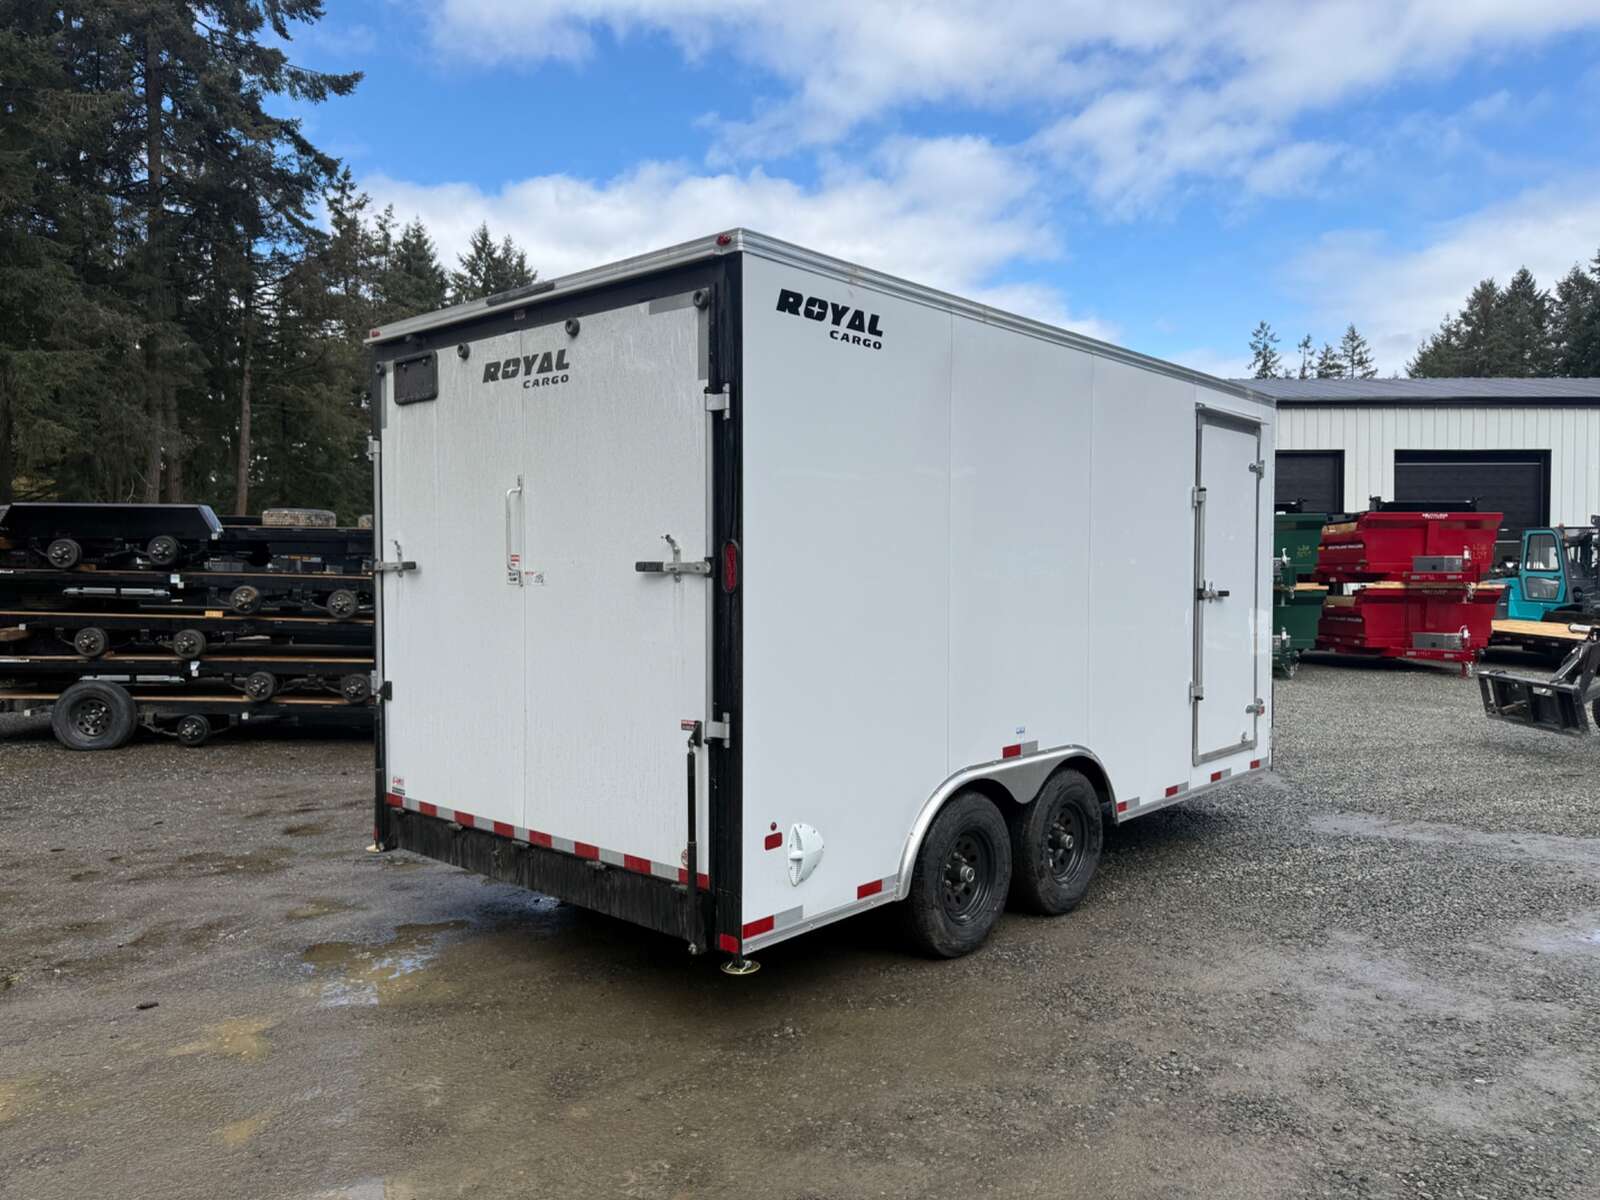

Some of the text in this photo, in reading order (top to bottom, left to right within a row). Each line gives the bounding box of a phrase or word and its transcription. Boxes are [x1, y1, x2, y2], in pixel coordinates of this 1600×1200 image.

[776, 288, 883, 338] ROYAL
[829, 330, 882, 350] CARGO
[482, 348, 570, 384] ROYAL
[523, 374, 569, 389] CARGO
